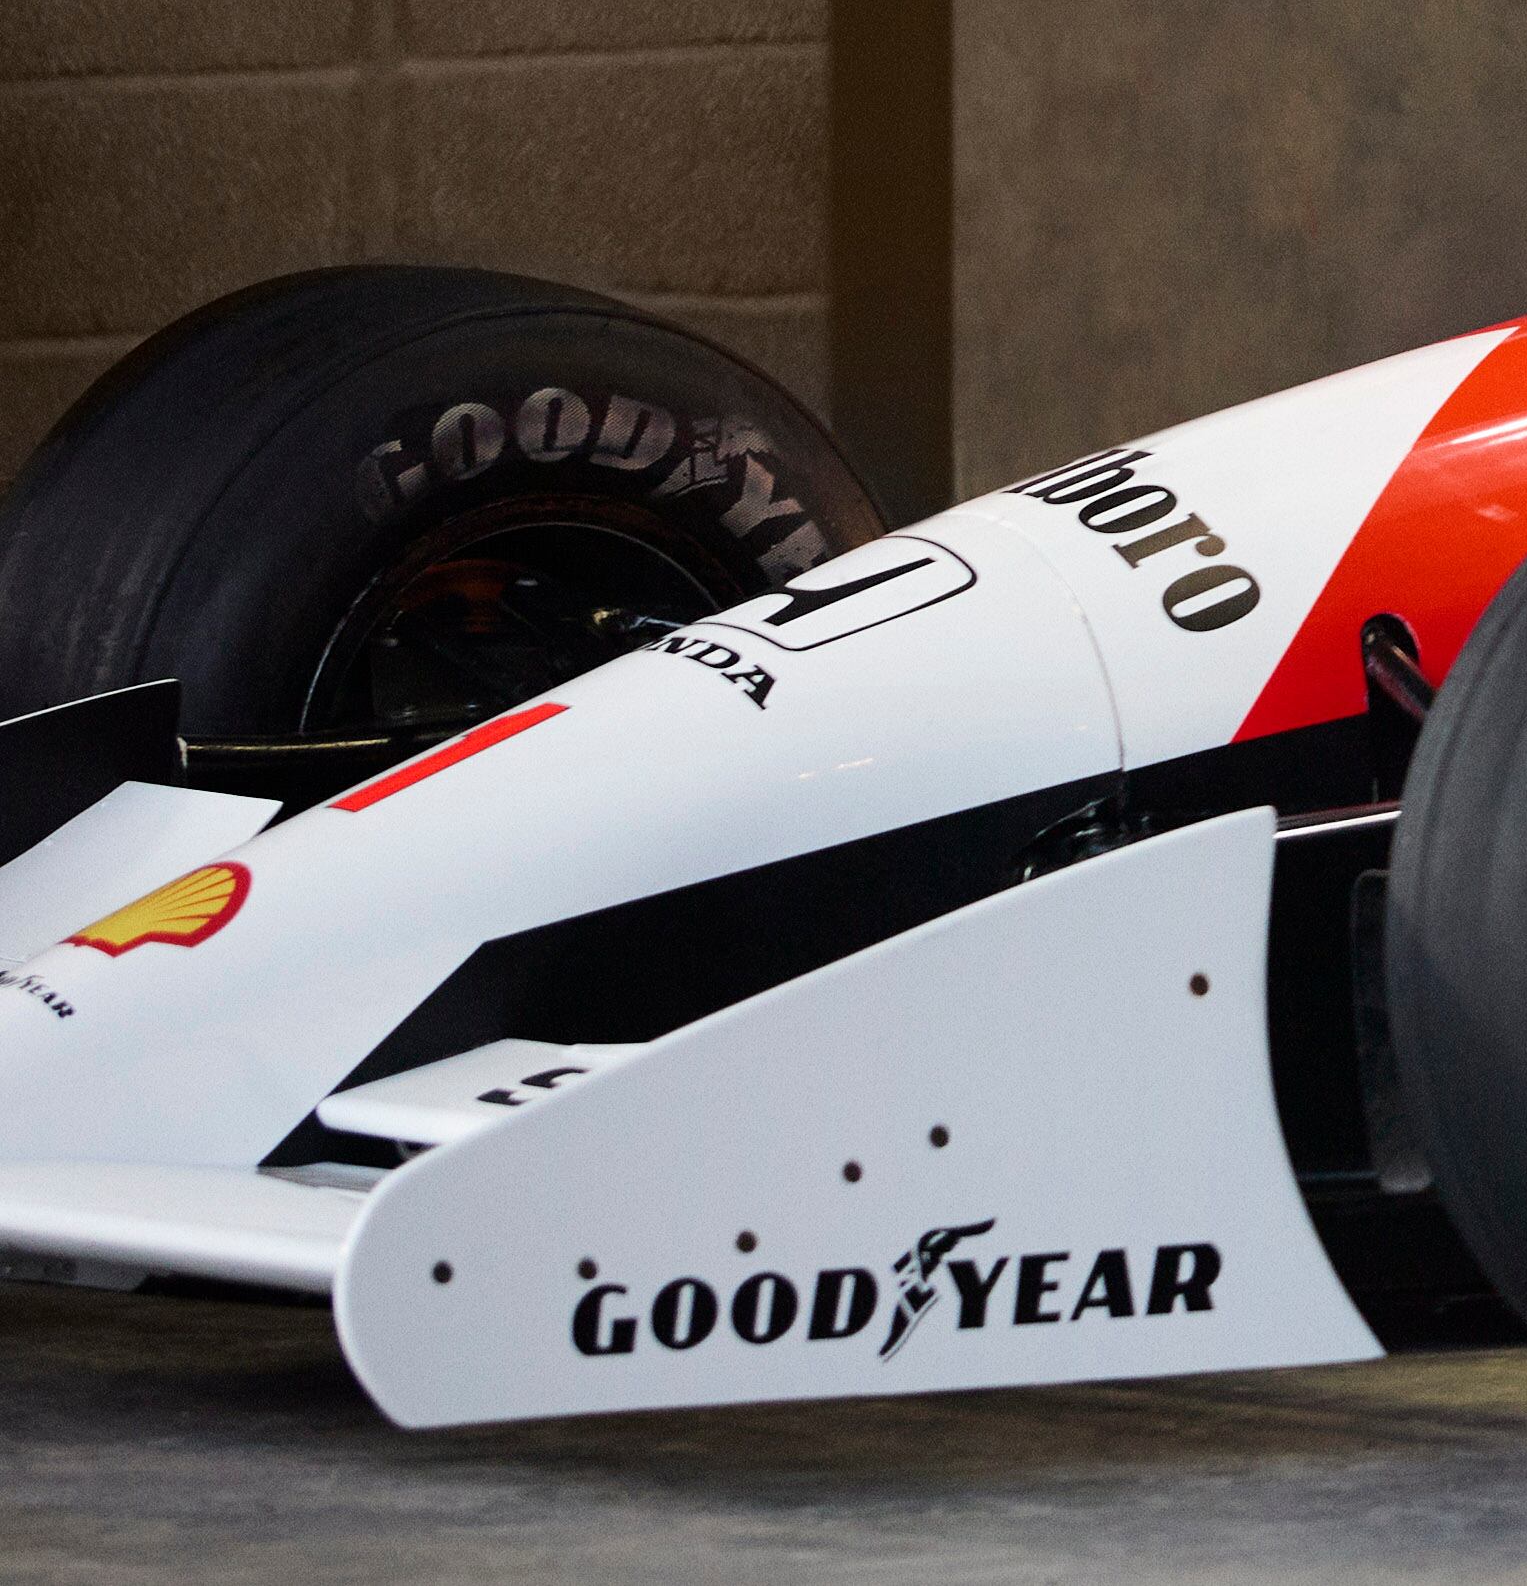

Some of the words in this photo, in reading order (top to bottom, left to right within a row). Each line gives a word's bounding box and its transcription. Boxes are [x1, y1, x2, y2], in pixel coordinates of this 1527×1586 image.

[1001, 448, 1261, 633] lboro
[642, 636, 777, 710] NDA
[571, 1242, 1223, 1358] GOODYEAR
